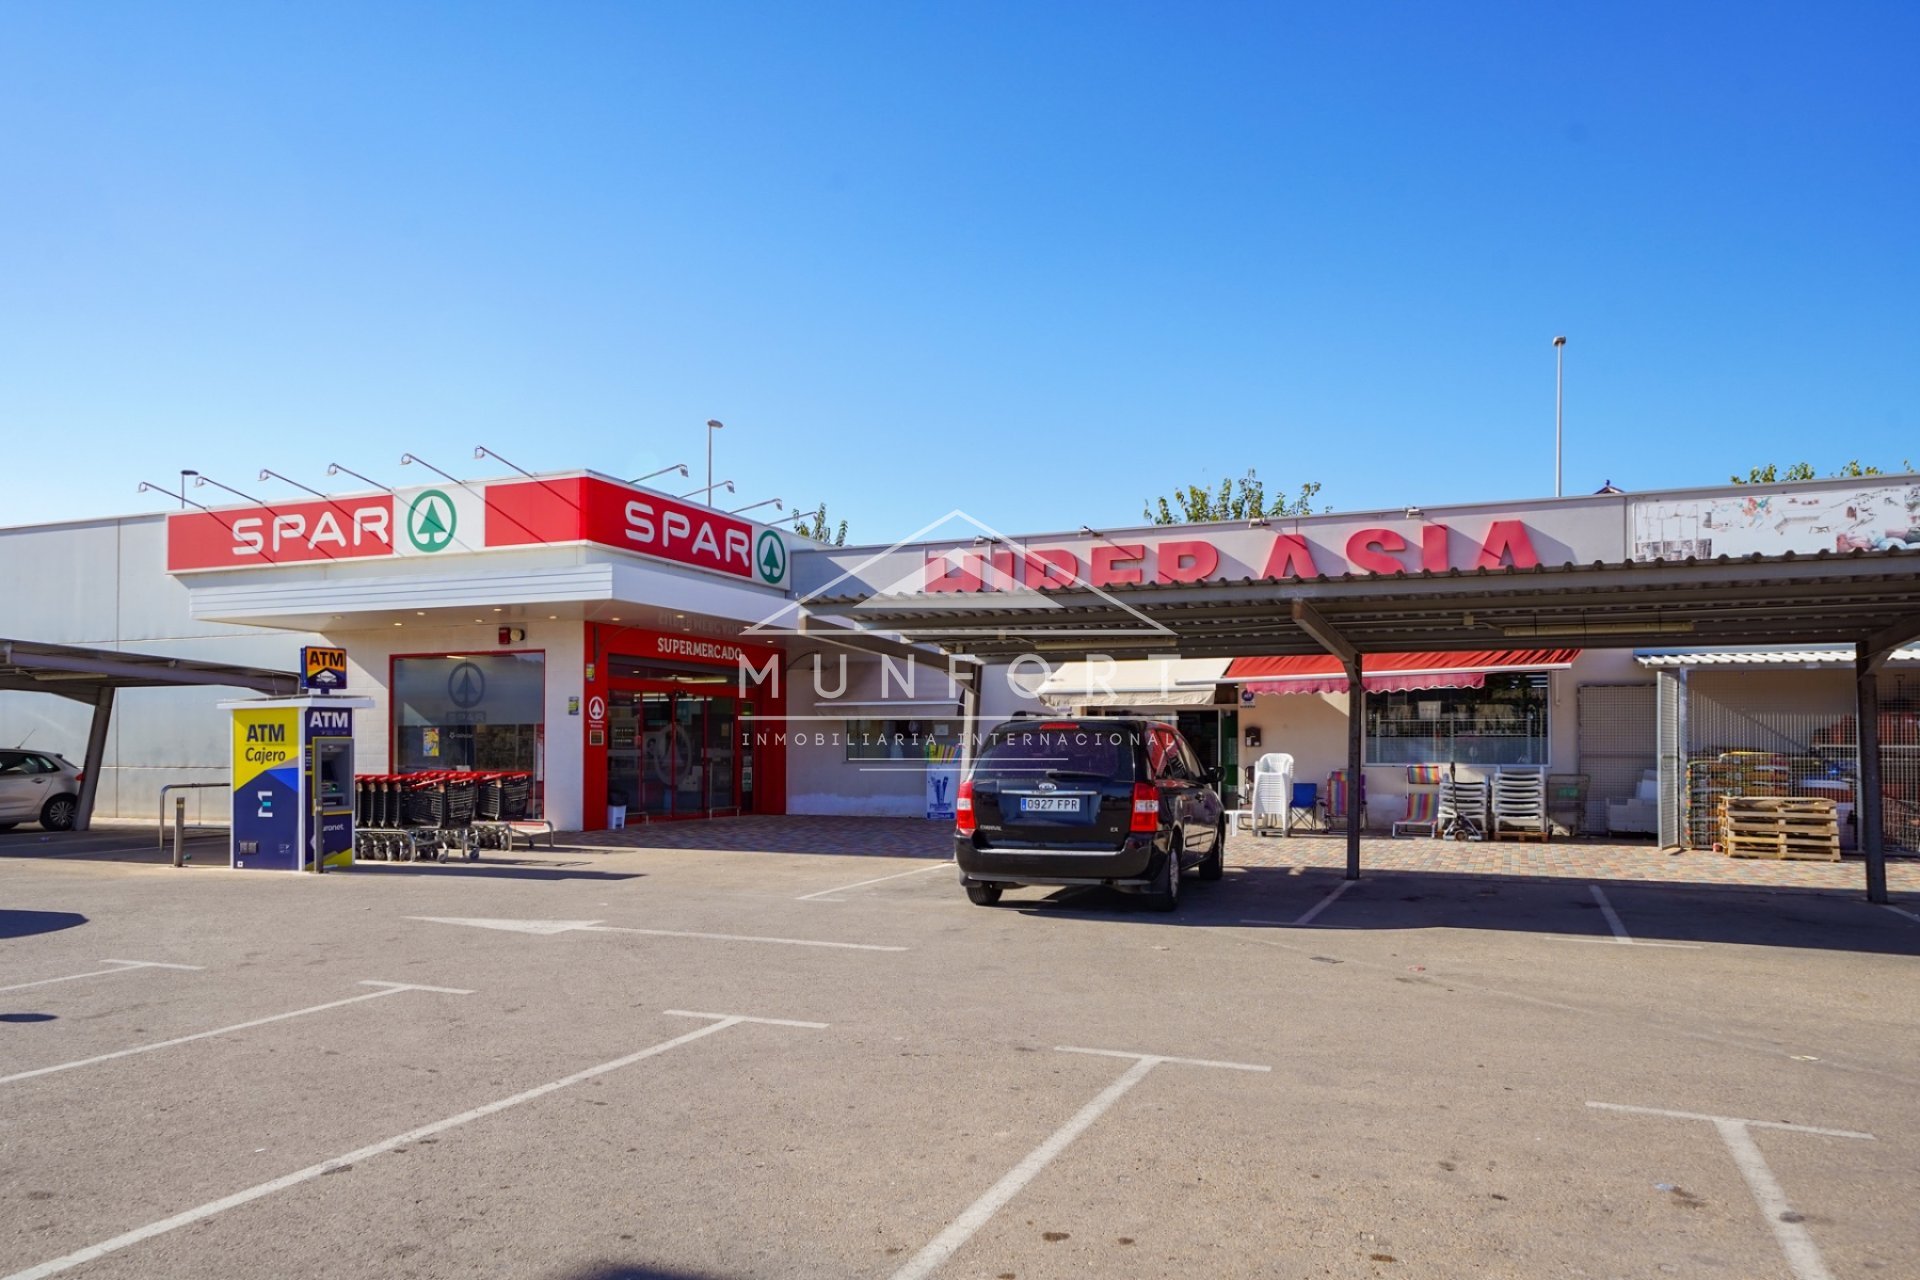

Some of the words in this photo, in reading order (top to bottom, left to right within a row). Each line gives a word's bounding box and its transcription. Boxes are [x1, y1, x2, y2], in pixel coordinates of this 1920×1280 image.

[232, 506, 389, 556] SPAR
[625, 500, 749, 567] SPAR
[1262, 520, 1540, 580] ASIA
[657, 637, 742, 661] SUPERMERCADO
[309, 651, 344, 667] ATM
[309, 711, 348, 728] ATM
[246, 724, 285, 742] ATM
[245, 747, 286, 765] Cajero
[1027, 800, 1052, 810] 0927
[1058, 800, 1078, 810] FPR
